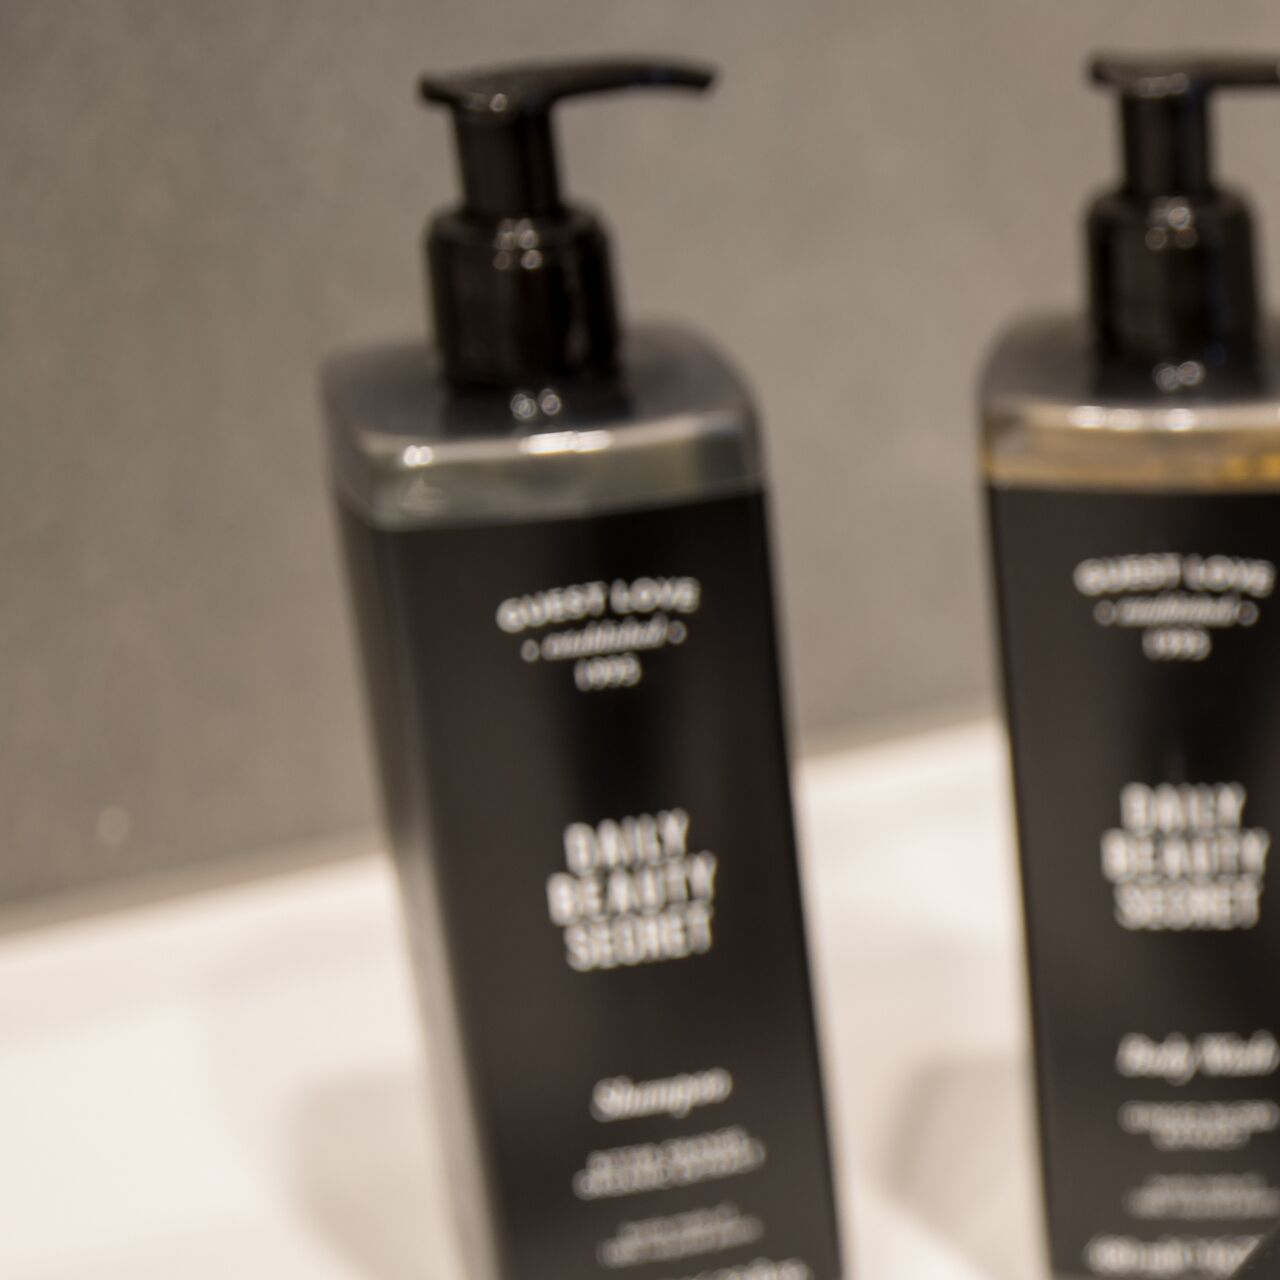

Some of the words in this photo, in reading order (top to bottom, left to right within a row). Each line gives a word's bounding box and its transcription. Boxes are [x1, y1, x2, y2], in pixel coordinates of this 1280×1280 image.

[496, 581, 605, 633] GUEST
[610, 576, 701, 613] LOVE
[1120, 781, 1247, 837] DAILY
[563, 807, 689, 876] DAILY
[1101, 827, 1271, 883] BEAUTY
[546, 850, 716, 925] BEAUTY
[1113, 875, 1264, 930] SECRET
[563, 902, 713, 972] SECRET
